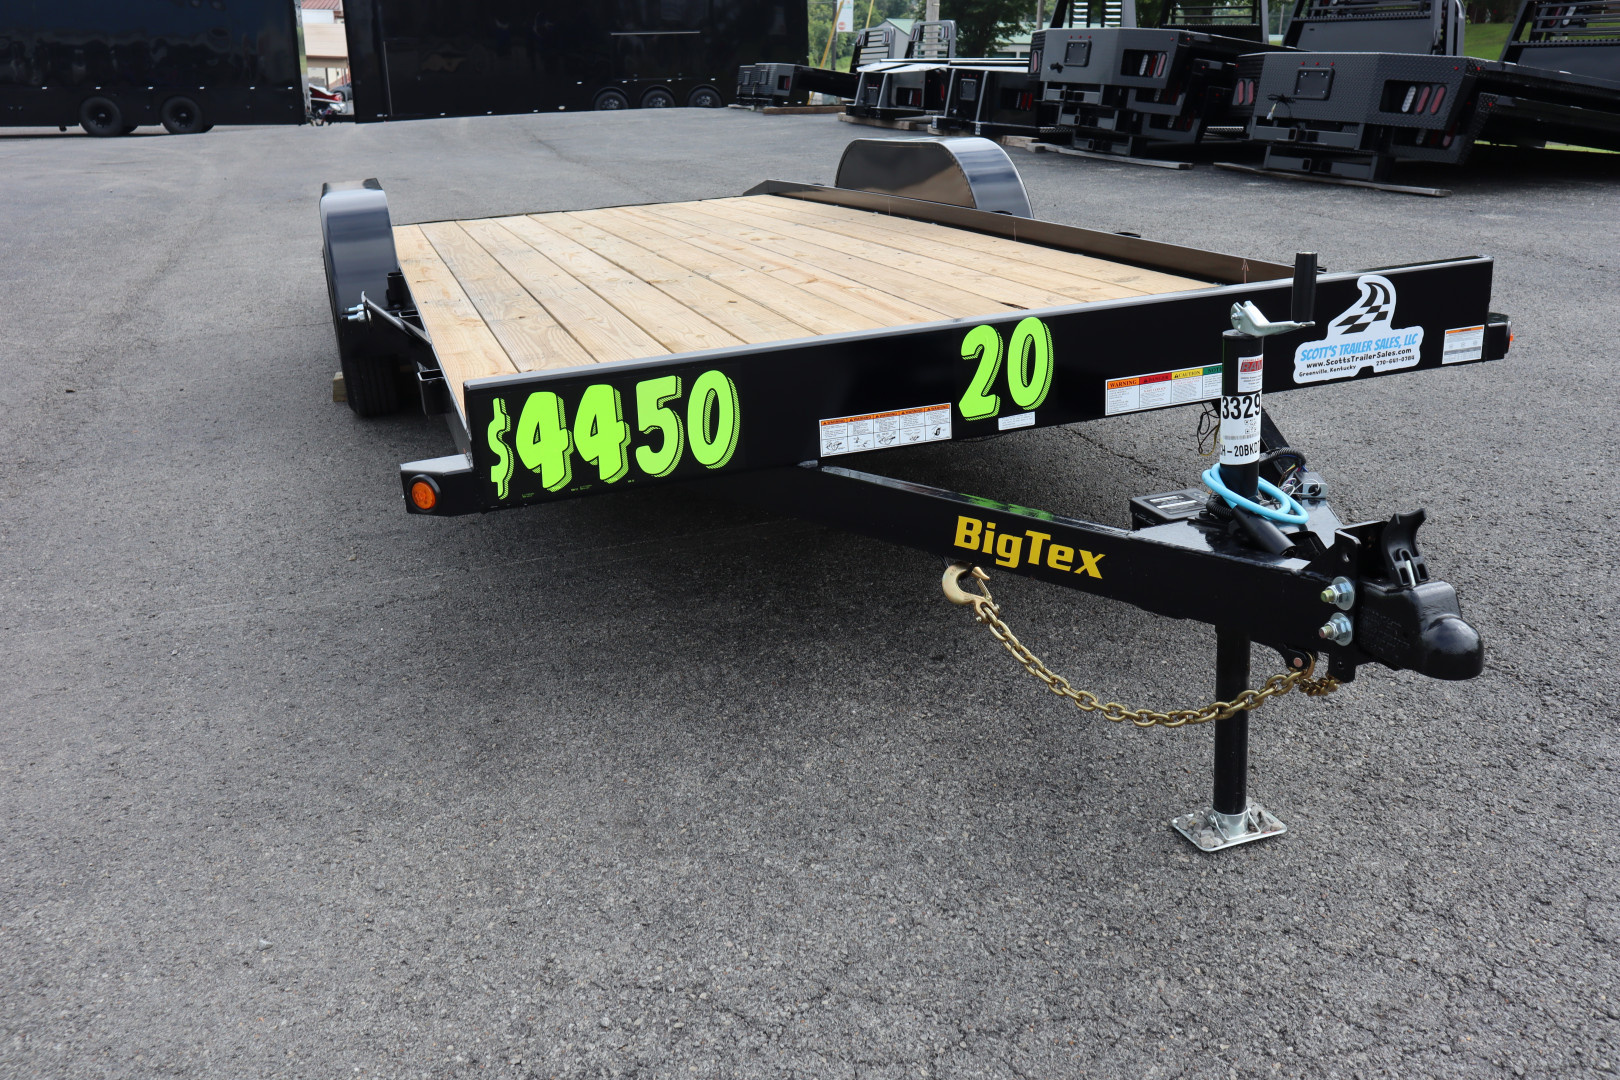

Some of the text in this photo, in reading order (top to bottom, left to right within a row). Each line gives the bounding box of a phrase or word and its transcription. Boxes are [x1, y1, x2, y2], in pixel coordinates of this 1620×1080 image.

[1301, 333, 1418, 361] SCOTT'S TRAILER SALES, LLC
[1306, 348, 1412, 368] www.ScottsTrailerSales.com
[959, 317, 1054, 421] 20
[1179, 370, 1201, 379] CAUTION
[1330, 365, 1357, 373] Kentucky
[1110, 380, 1137, 388] WARNING
[1222, 393, 1261, 420] 3329
[488, 370, 741, 500] $4450
[954, 515, 1106, 580] BigTex
